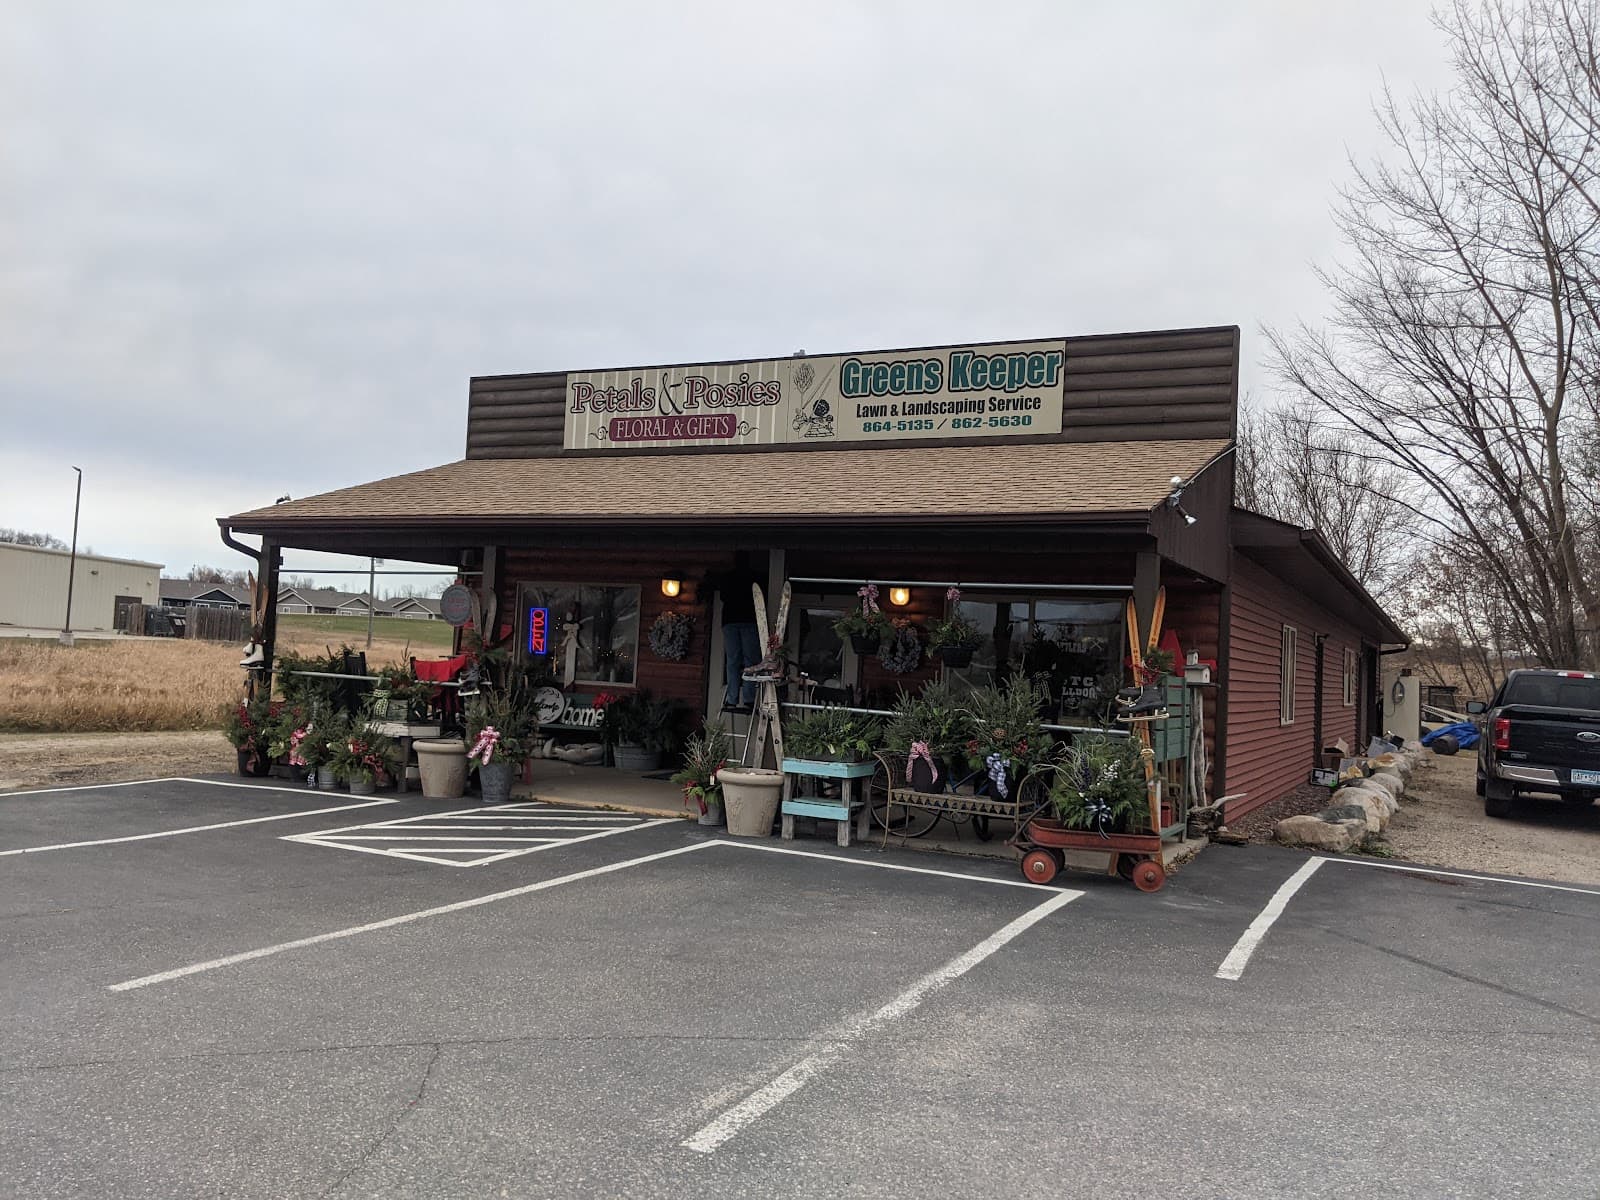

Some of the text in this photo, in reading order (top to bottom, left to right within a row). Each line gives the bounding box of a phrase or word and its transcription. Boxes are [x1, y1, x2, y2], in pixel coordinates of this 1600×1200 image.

[841, 351, 1064, 398] Greens Keeper
[572, 372, 782, 416] Petals & Posies
[856, 395, 1041, 418] Lawn & Landscaping Service
[616, 416, 729, 438] FLORAL & GIFTS
[862, 420, 934, 432] 864-5135
[951, 414, 1032, 429] 862-5630
[532, 609, 545, 652] OPEN
[561, 697, 605, 727] home
